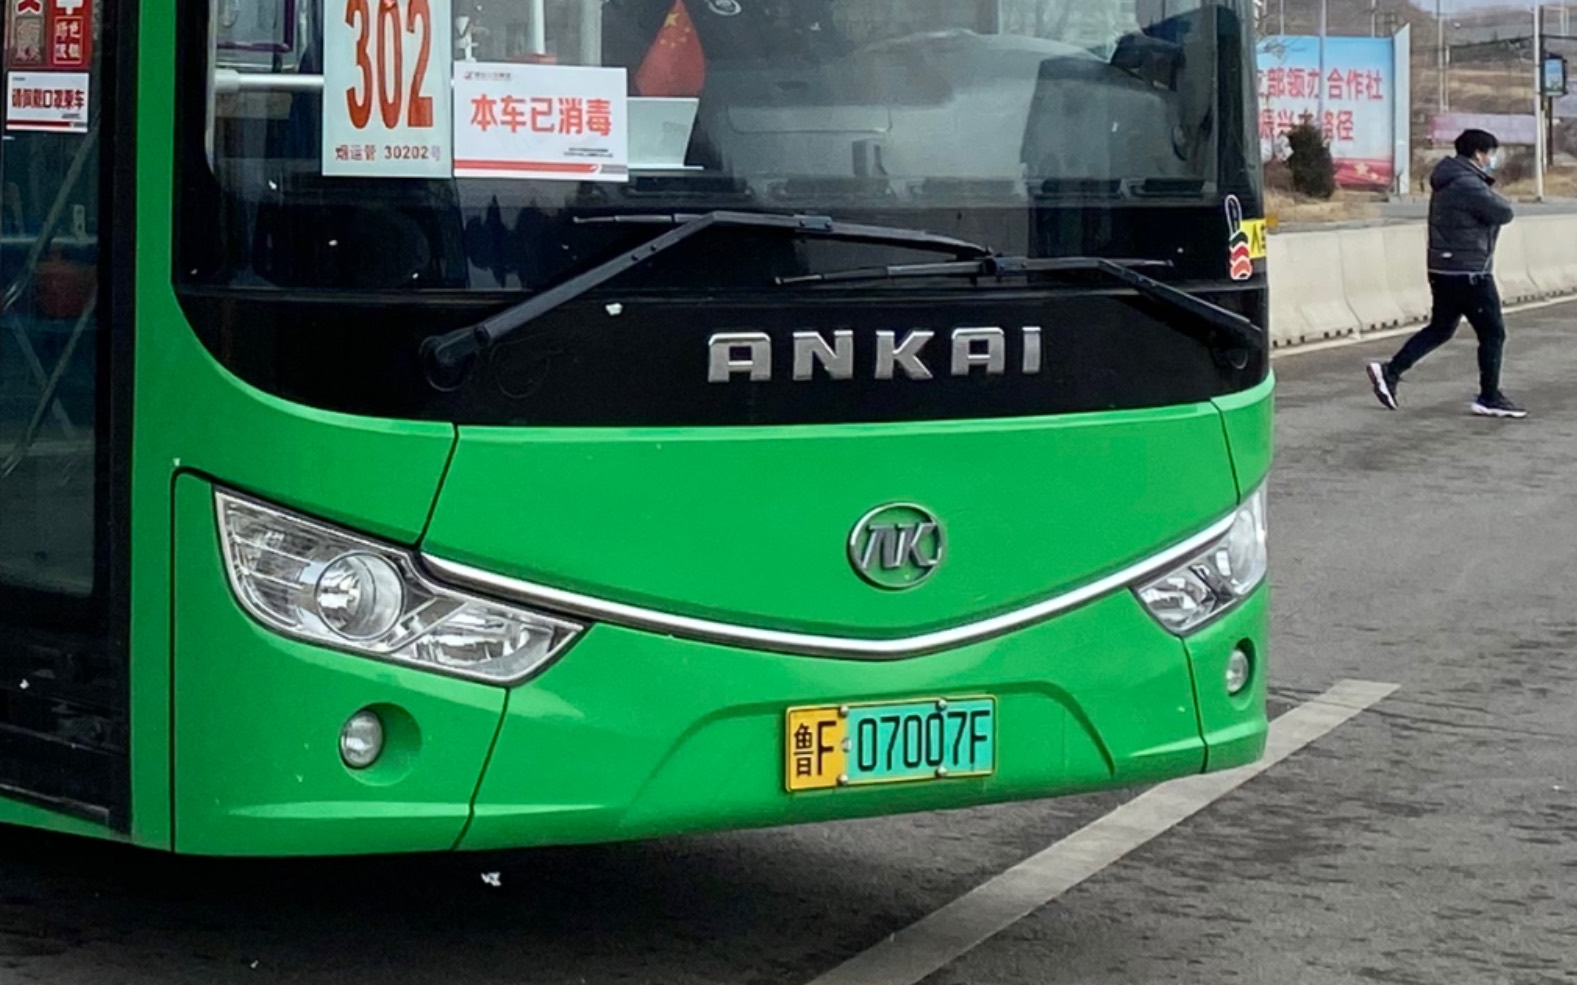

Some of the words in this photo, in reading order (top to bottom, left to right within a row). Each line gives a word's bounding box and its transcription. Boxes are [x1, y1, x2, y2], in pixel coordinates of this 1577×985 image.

[1257, 67, 1384, 101] 部领办合作社
[470, 94, 612, 136] 本车已消毒
[1258, 108, 1354, 141] 振兴路径
[708, 326, 1042, 383] ANKAI
[857, 710, 991, 772] 07007F
